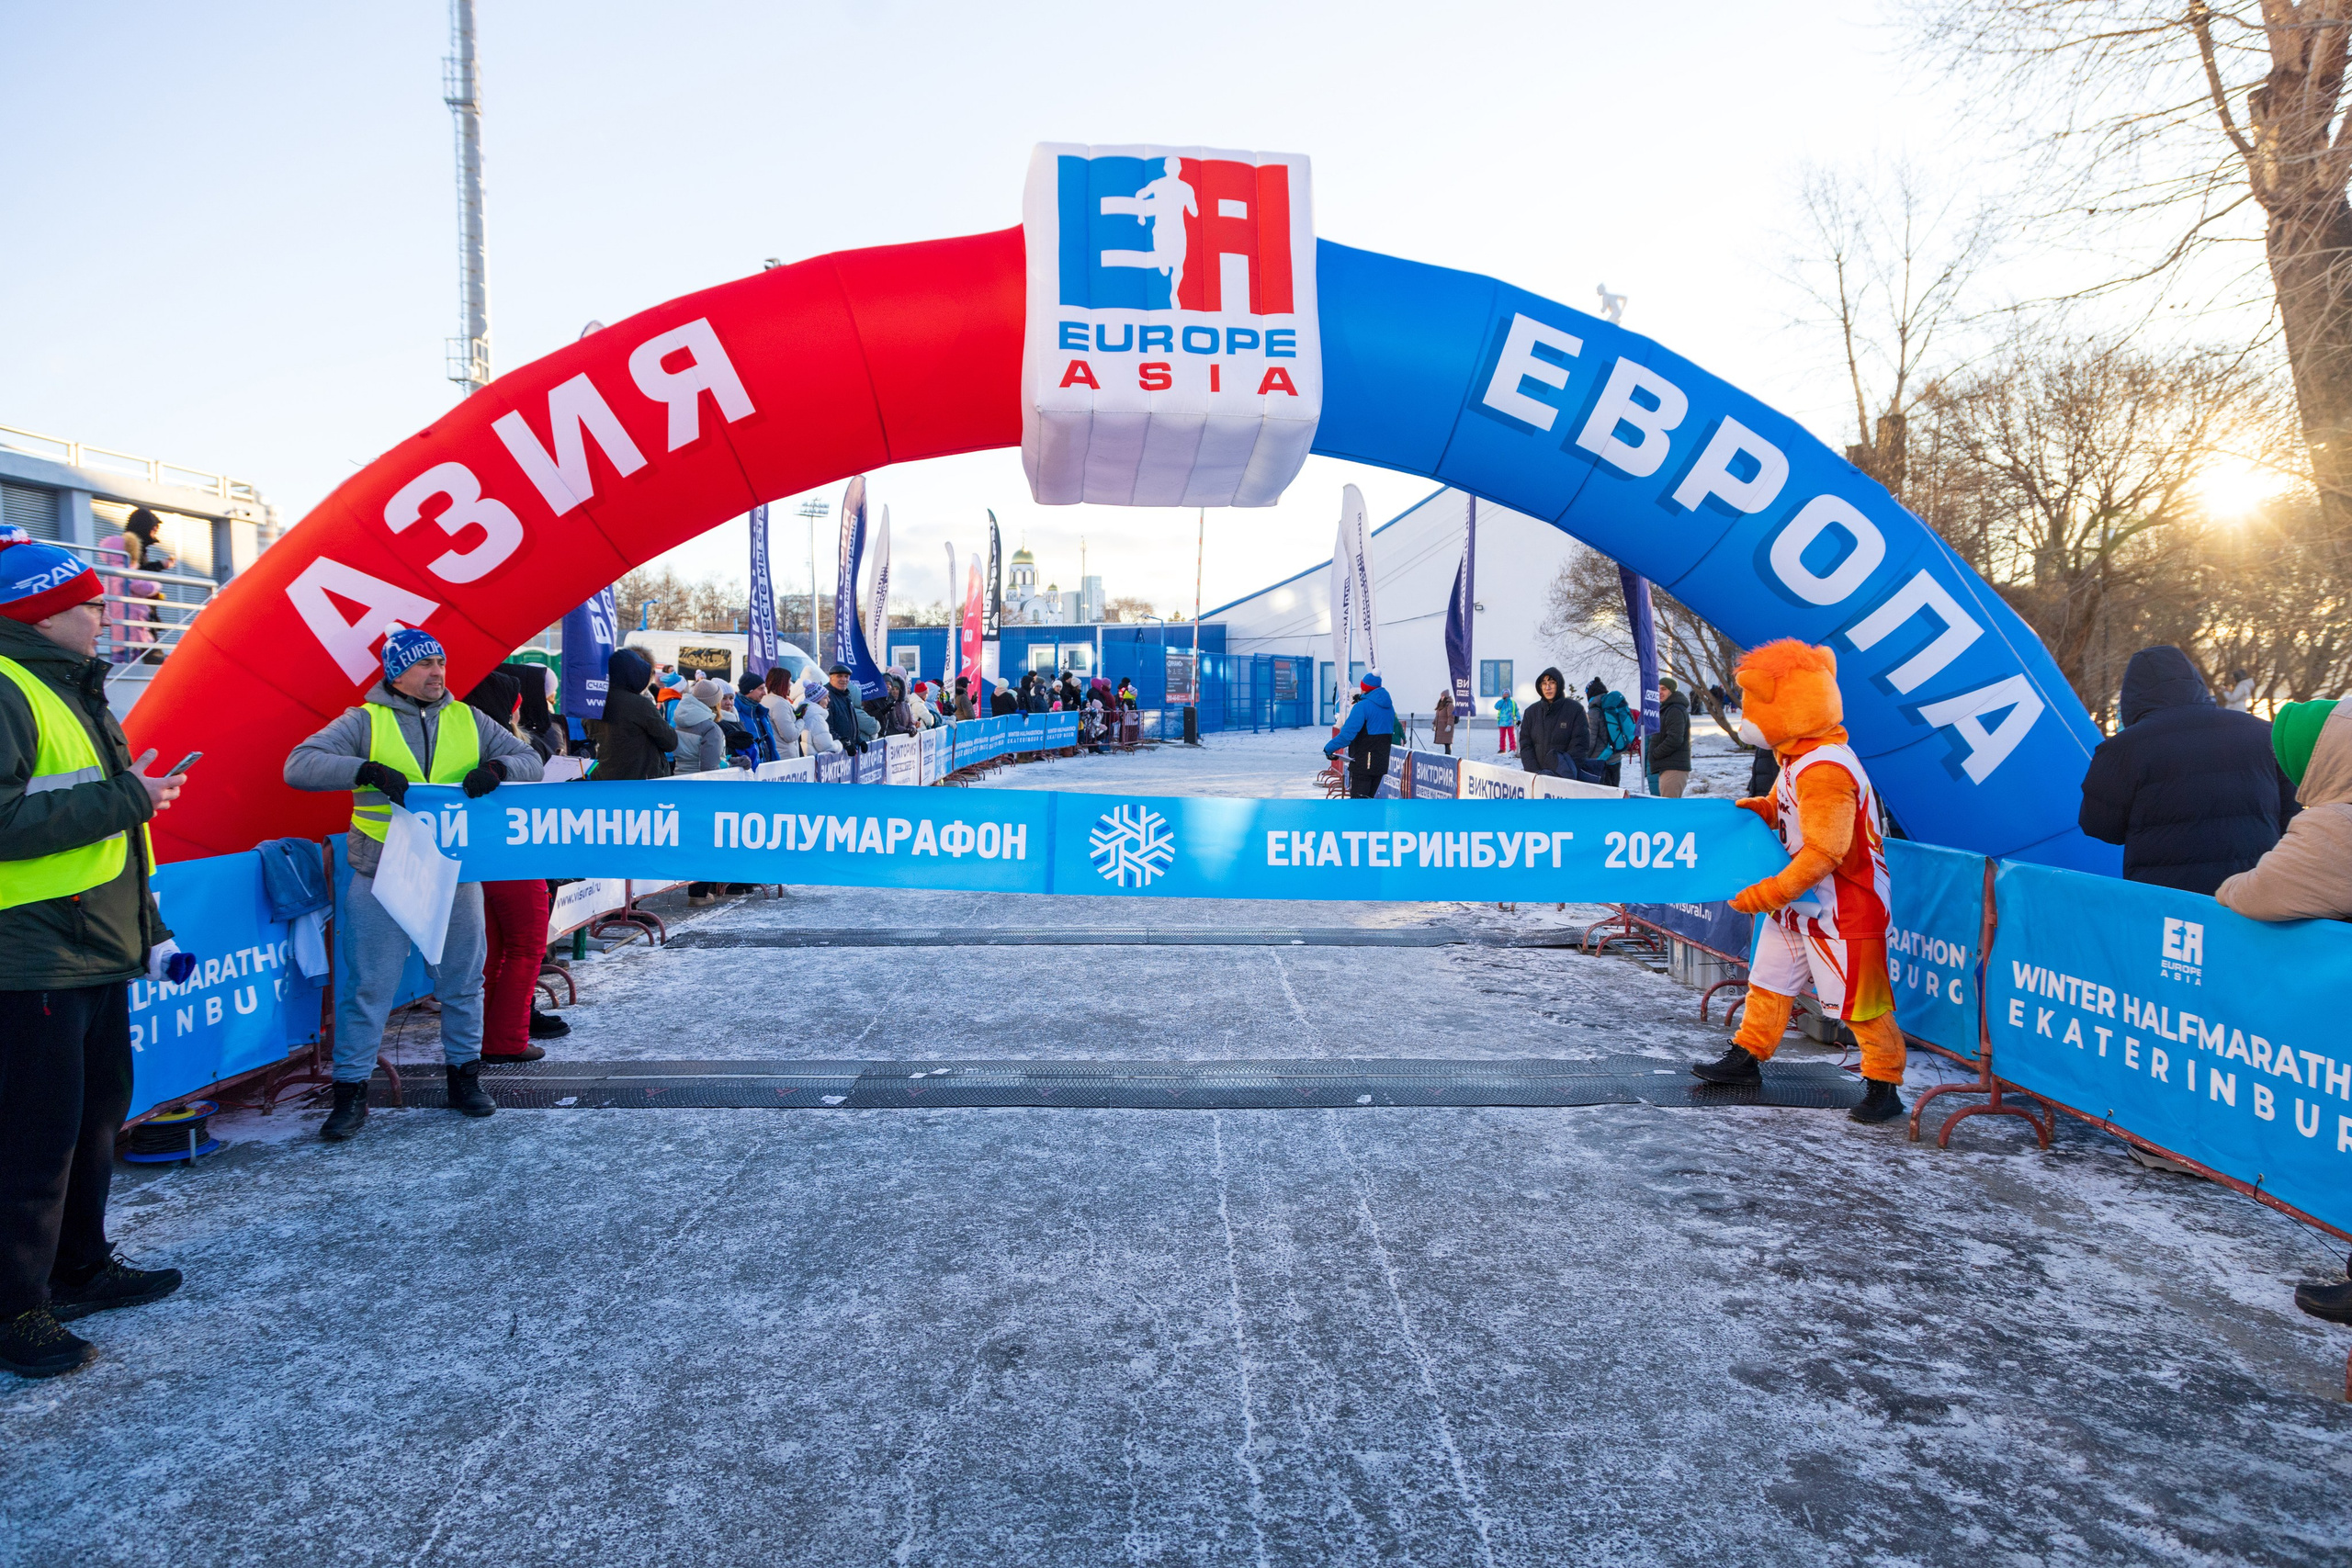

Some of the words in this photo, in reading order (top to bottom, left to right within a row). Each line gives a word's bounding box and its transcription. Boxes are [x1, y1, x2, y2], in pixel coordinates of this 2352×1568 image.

[1058, 321, 1296, 358] EUROPE
[1058, 359, 1299, 396] ASIA
[285, 317, 756, 686] АЗИЯ
[758, 550, 765, 577] мы
[1482, 312, 2045, 785] ЕВРОПА
[759, 584, 774, 658] вместе
[399, 641, 444, 668] EUROP
[1417, 762, 1453, 787] ВИКТОРИЯ
[506, 803, 680, 847] ЗИМНИЙ
[714, 810, 1027, 860] ПОЛУМАРАФОН
[1267, 830, 1574, 868] ЕКАТЕРИНБУРГ
[1604, 831, 1698, 869] 2024
[1889, 957, 1964, 1005] BURG
[2160, 969, 2202, 987] ASIA
[2161, 959, 2203, 977] EUROPE
[2012, 960, 2117, 1019] WINTER
